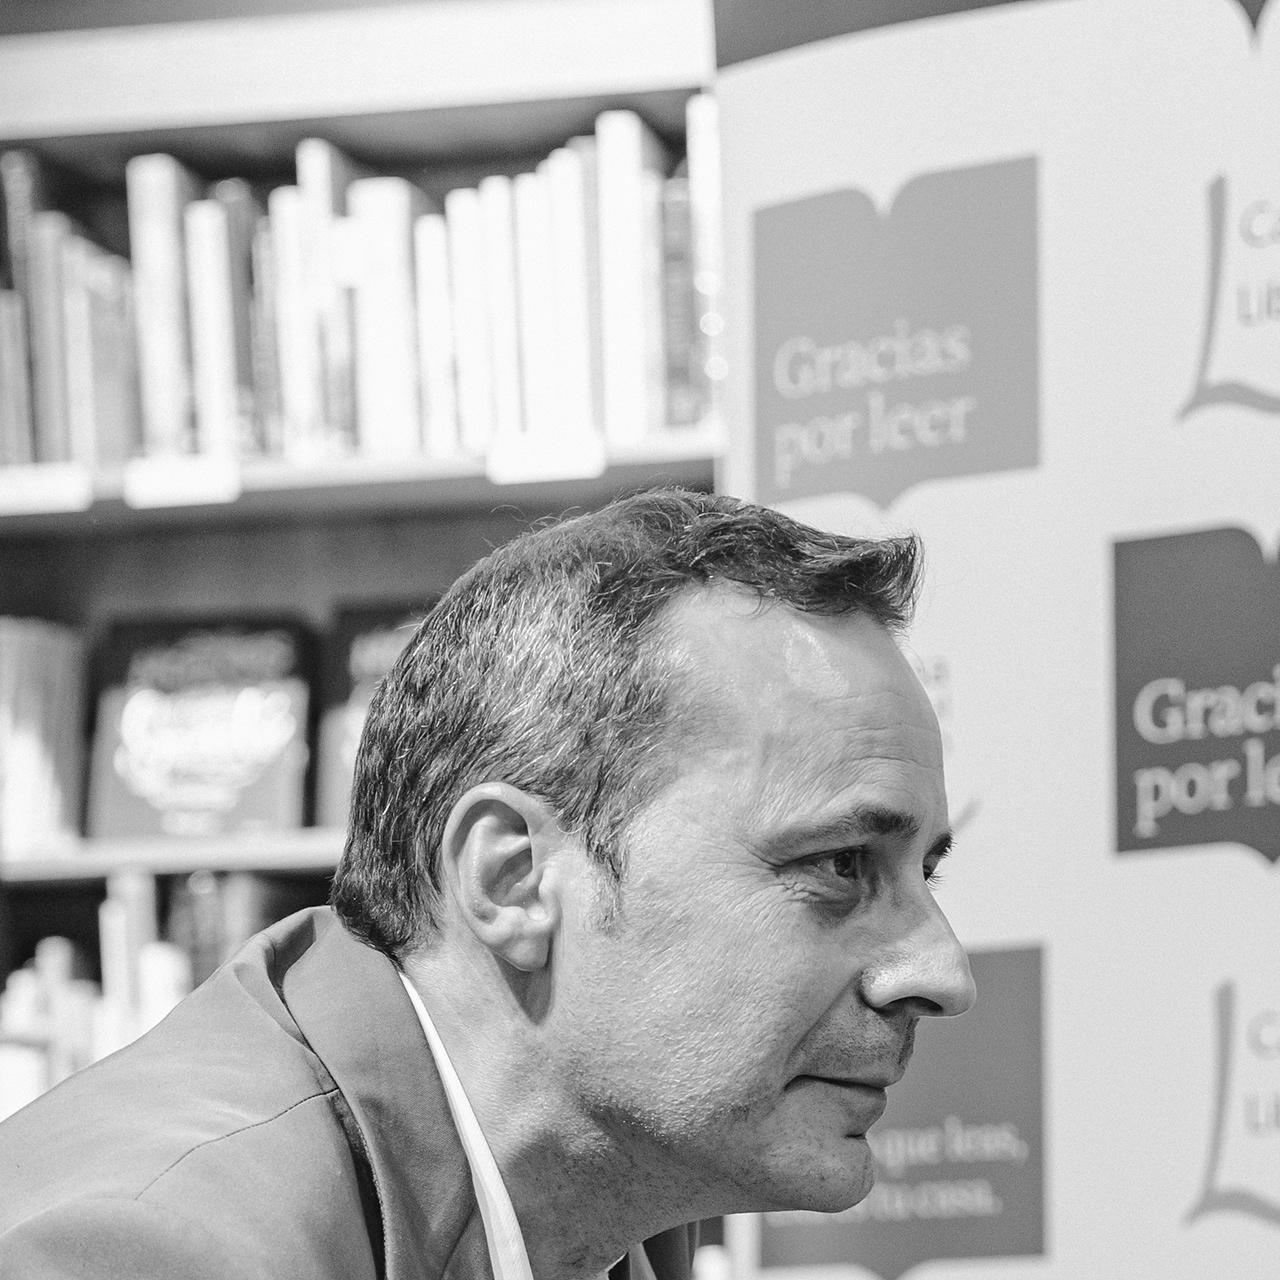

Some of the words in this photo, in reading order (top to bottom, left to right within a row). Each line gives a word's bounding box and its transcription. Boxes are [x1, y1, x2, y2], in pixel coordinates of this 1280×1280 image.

[773, 318, 972, 399] Gracias
[774, 409, 864, 489] por
[867, 392, 975, 454] leer
[1134, 759, 1241, 838] por
